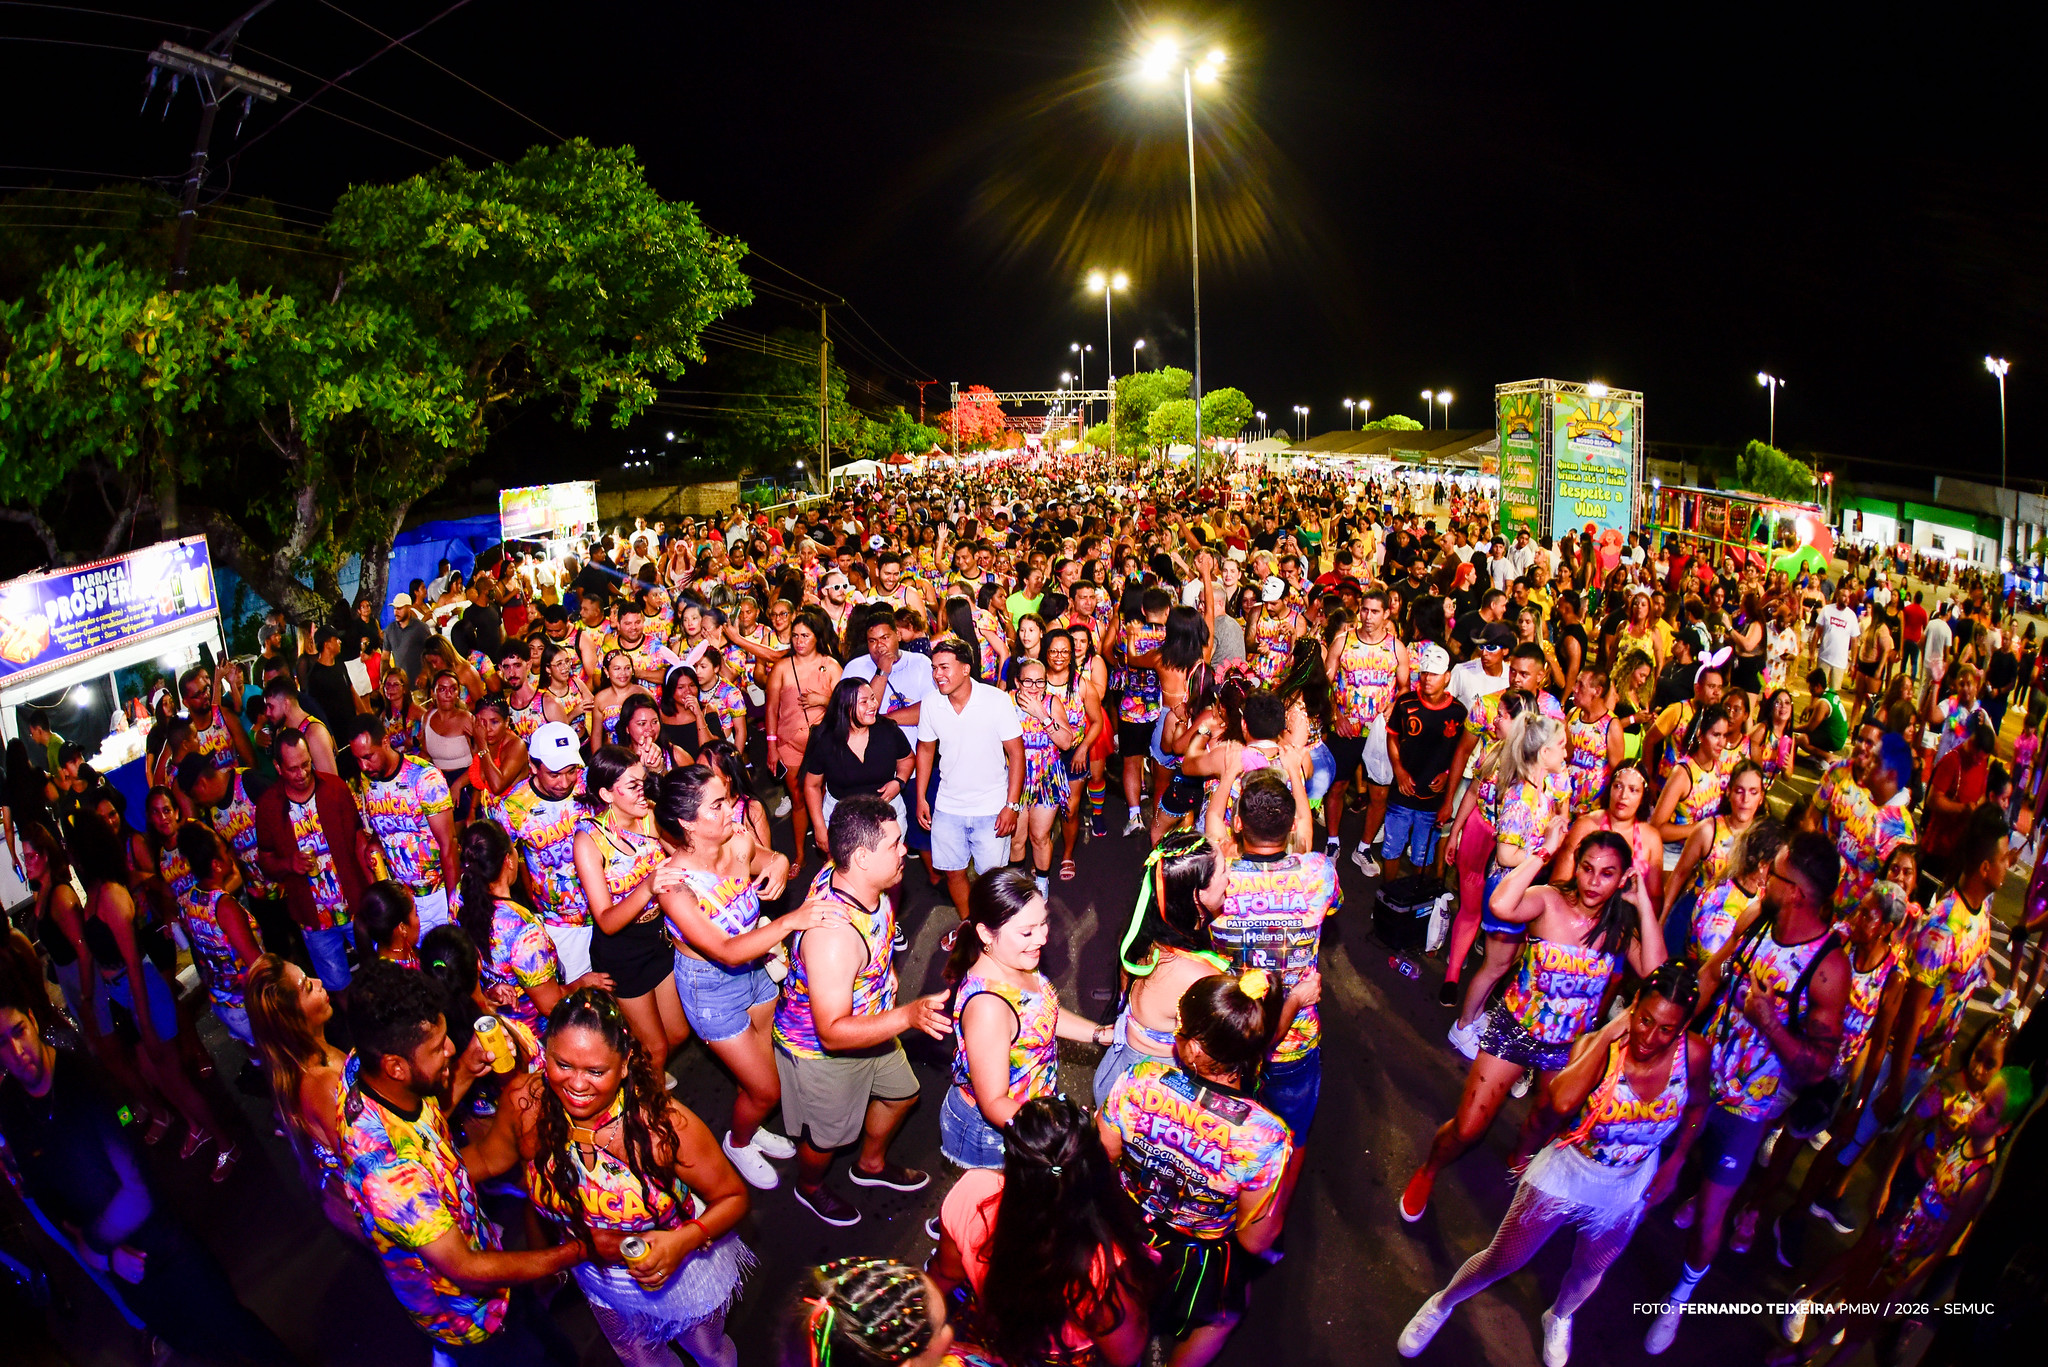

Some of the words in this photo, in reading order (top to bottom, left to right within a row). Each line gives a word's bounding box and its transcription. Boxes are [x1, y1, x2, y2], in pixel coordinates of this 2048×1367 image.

[1557, 460, 1578, 471] Quem
[1580, 462, 1605, 474] brinca
[1607, 465, 1627, 477] legal,
[1557, 471, 1582, 482] brinca
[1583, 473, 1597, 483] até
[1559, 482, 1611, 502] Respeite
[1615, 491, 1623, 502] a
[1574, 501, 1607, 519] VIDA!
[72, 566, 125, 592] BARRACA
[45, 580, 134, 628] PROSPER
[1346, 657, 1389, 671] DANÇA
[199, 735, 228, 755] ANÇA
[369, 797, 411, 818] DANÇA
[294, 813, 323, 840] ANÇ
[1226, 874, 1304, 896] DANÇA
[1227, 919, 1303, 928] PATROCINADORES
[1246, 932, 1284, 943] Helena
[1544, 947, 1608, 979] DANÇA
[1159, 1077, 1197, 1101] MOVIMENTO
[1144, 1088, 1230, 1150] DANÇA
[1600, 1098, 1678, 1123] DANÇA
[577, 1185, 653, 1224] NÇA
